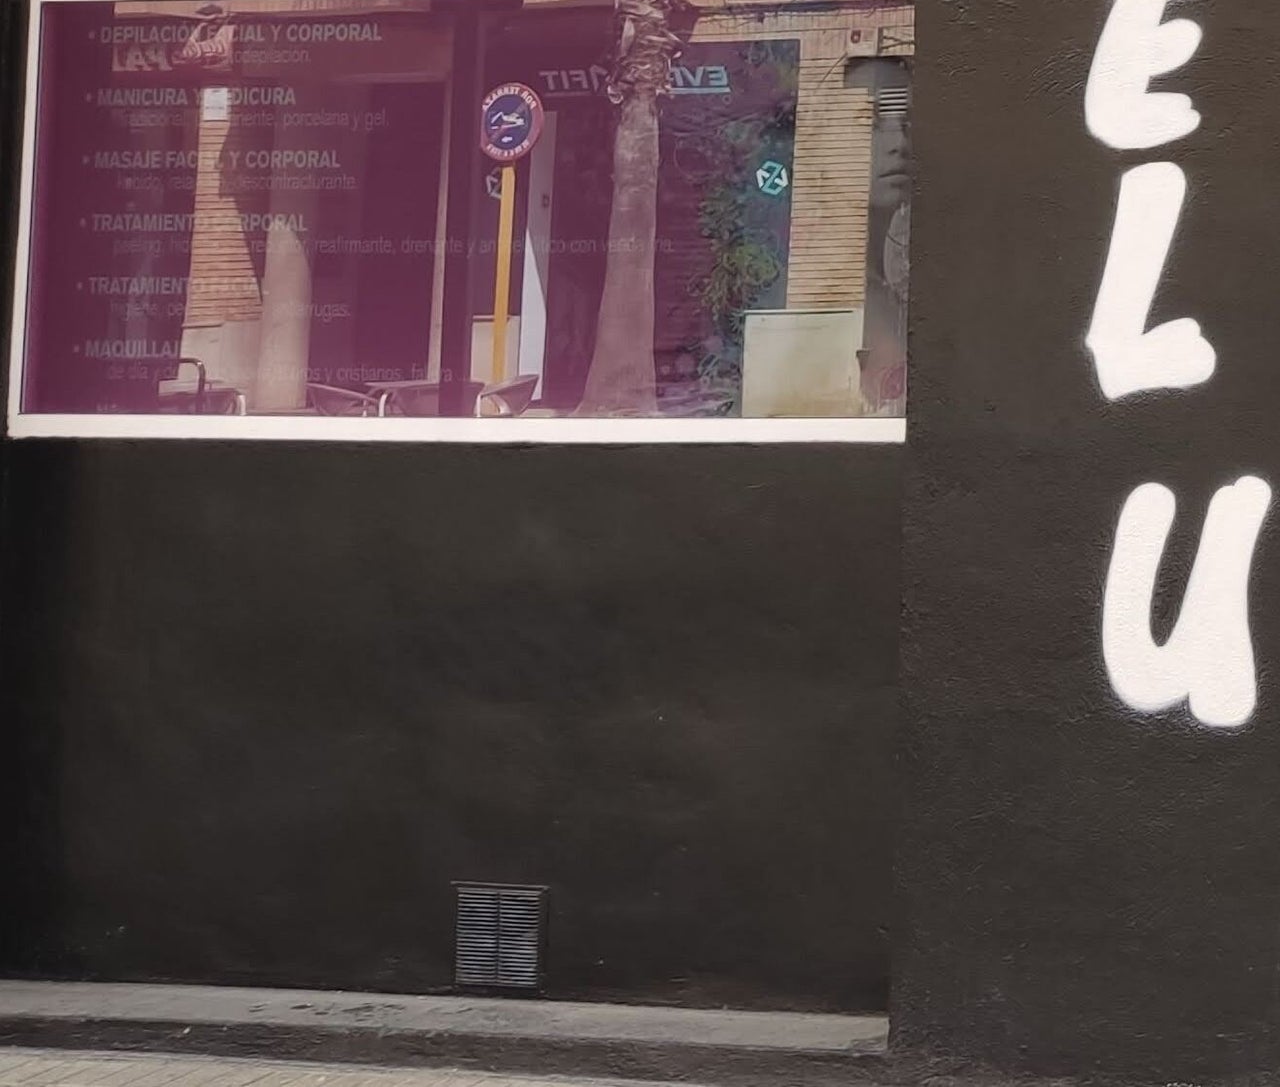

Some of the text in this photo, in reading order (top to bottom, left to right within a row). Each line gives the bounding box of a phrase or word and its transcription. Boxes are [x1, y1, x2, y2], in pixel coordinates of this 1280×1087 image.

[207, 24, 265, 42] FCIAL
[271, 24, 283, 42] Y
[286, 23, 382, 42] CORPORAL
[97, 87, 189, 106] MANICURA
[205, 87, 296, 105] DICURA
[94, 150, 341, 169] MASAJE FACL Y CORPORAL
[92, 213, 206, 232] TRATAMIENT
[88, 278, 202, 296] TRATAMIENT
[84, 339, 193, 359] MAQUILLAJ
